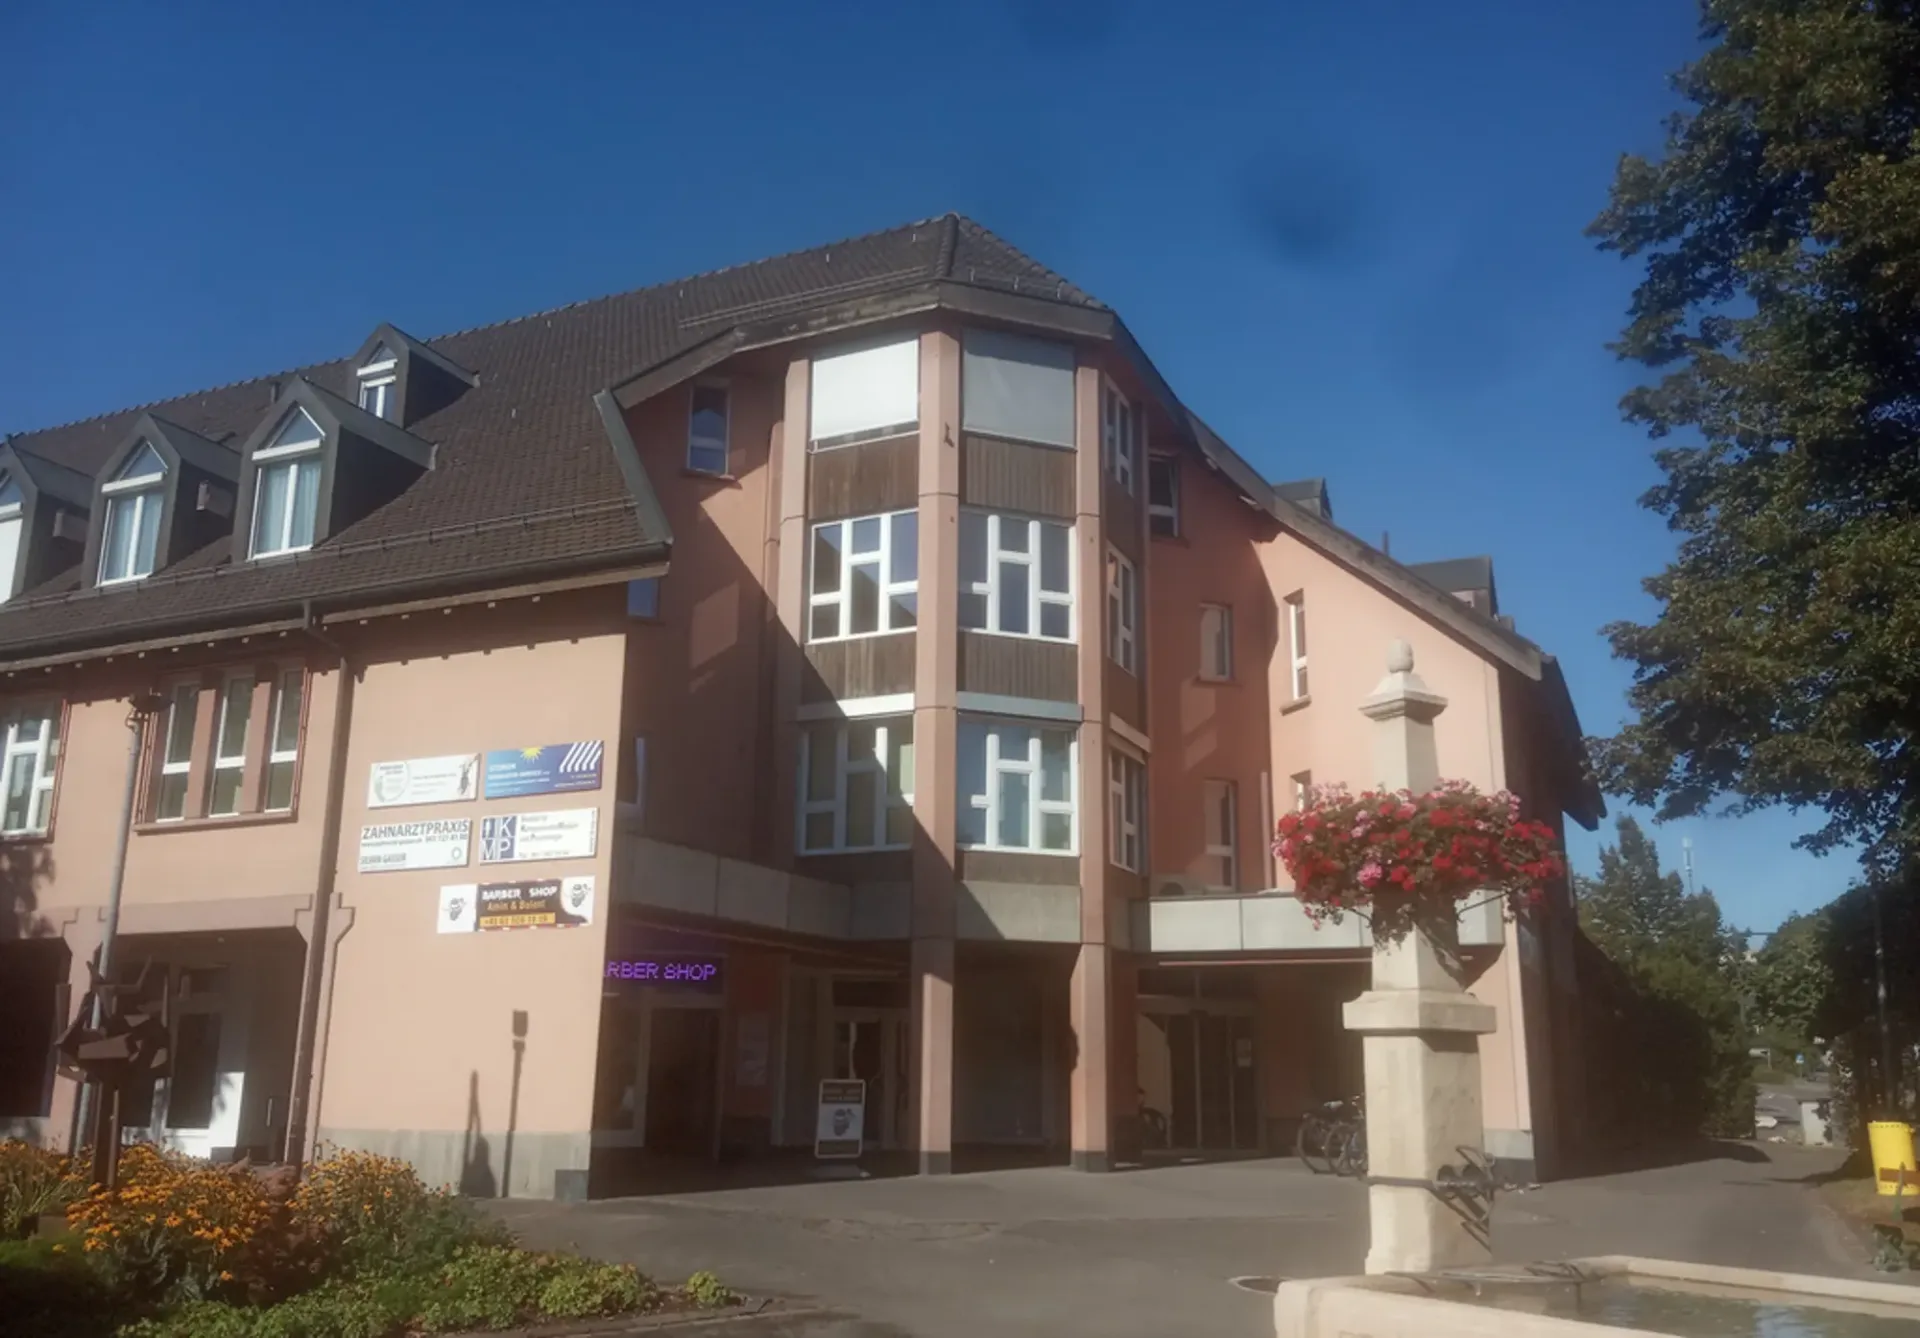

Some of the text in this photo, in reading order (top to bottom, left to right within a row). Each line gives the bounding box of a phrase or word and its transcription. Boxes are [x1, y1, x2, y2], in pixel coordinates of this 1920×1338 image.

[363, 820, 468, 840] ZAHNARZTPRAXIS
[482, 886, 558, 901] BARBER SHOP
[603, 961, 716, 980] RBER SHOP
